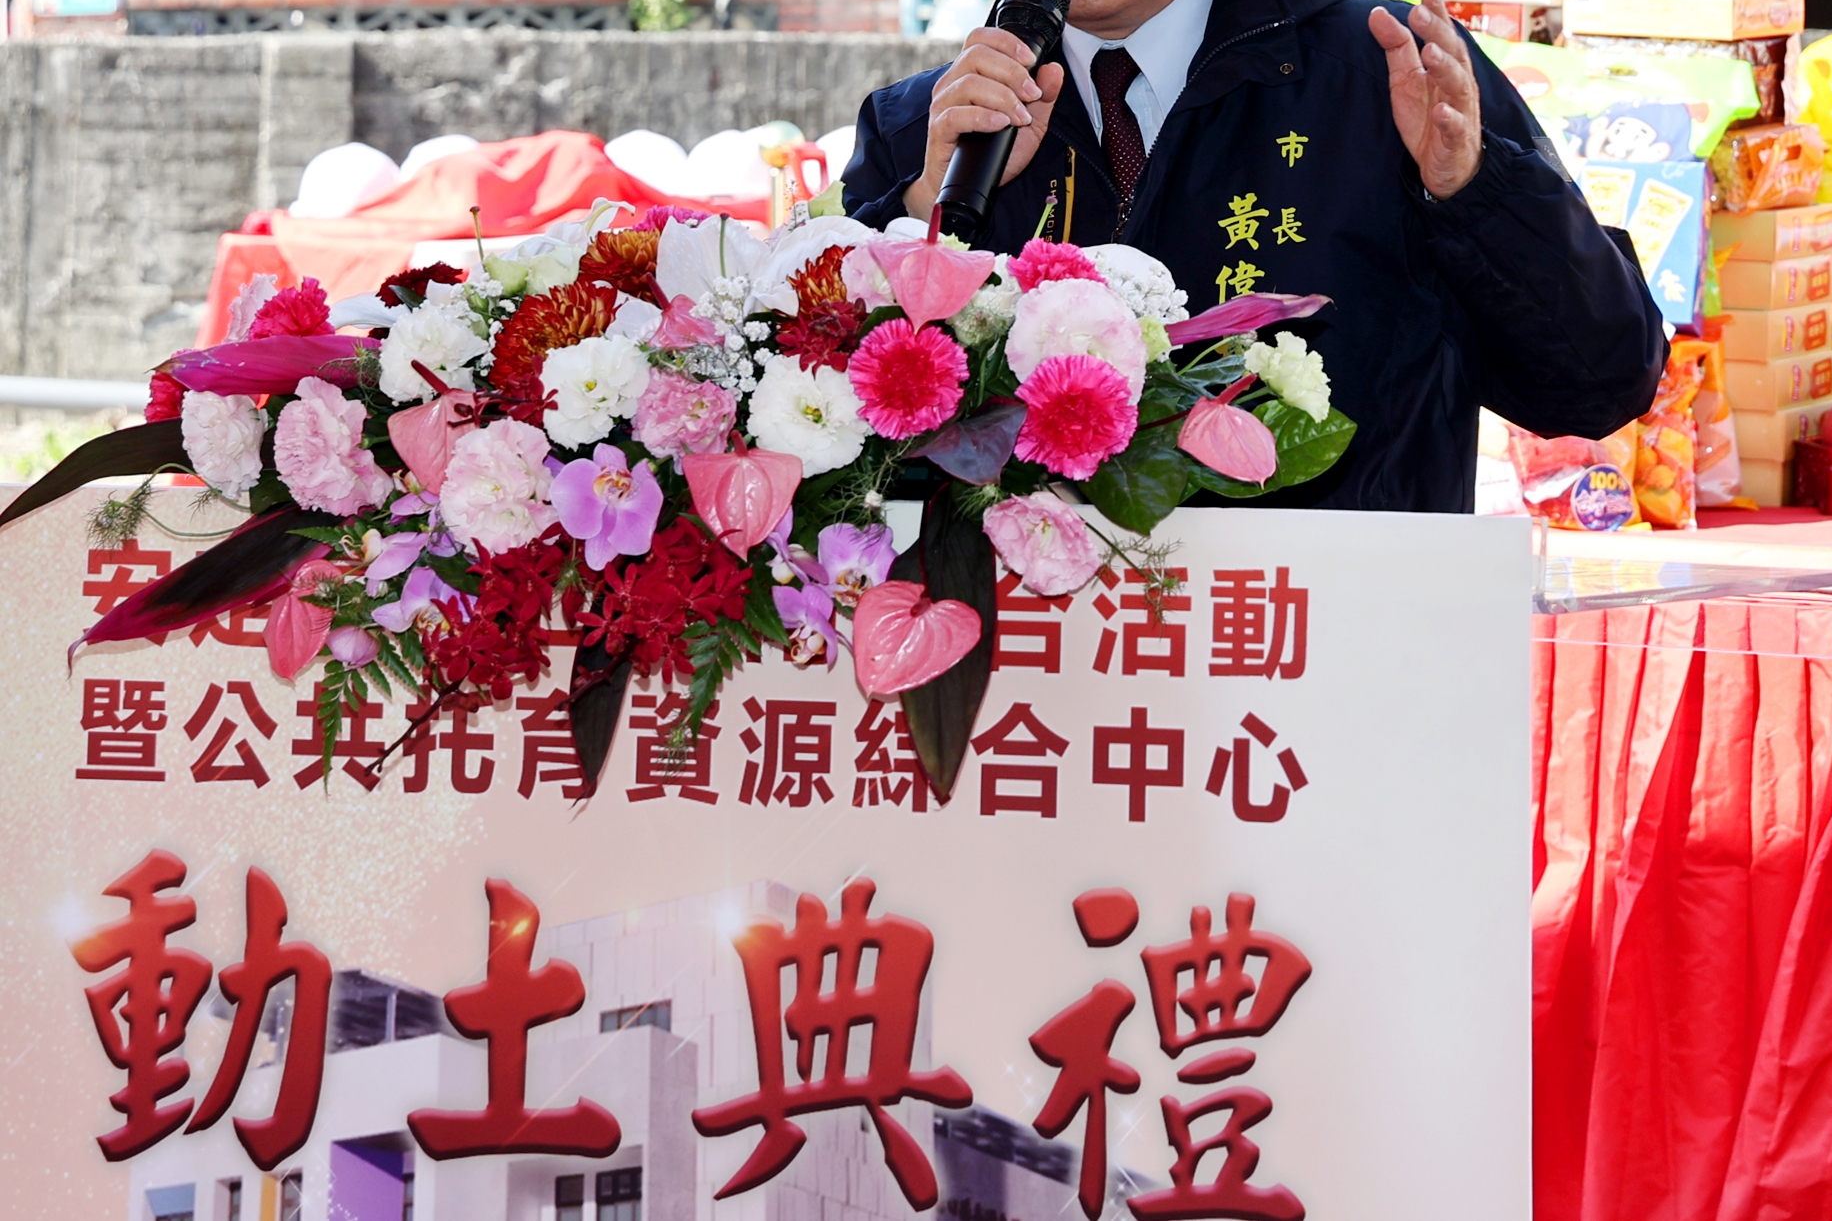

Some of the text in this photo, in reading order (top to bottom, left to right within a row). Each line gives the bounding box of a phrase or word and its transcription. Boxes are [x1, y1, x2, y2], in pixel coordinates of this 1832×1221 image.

[1044, 179, 1058, 243] CHMOIS
[1272, 130, 1309, 245] 市長
[65, 846, 1313, 1221] 動土典禮
